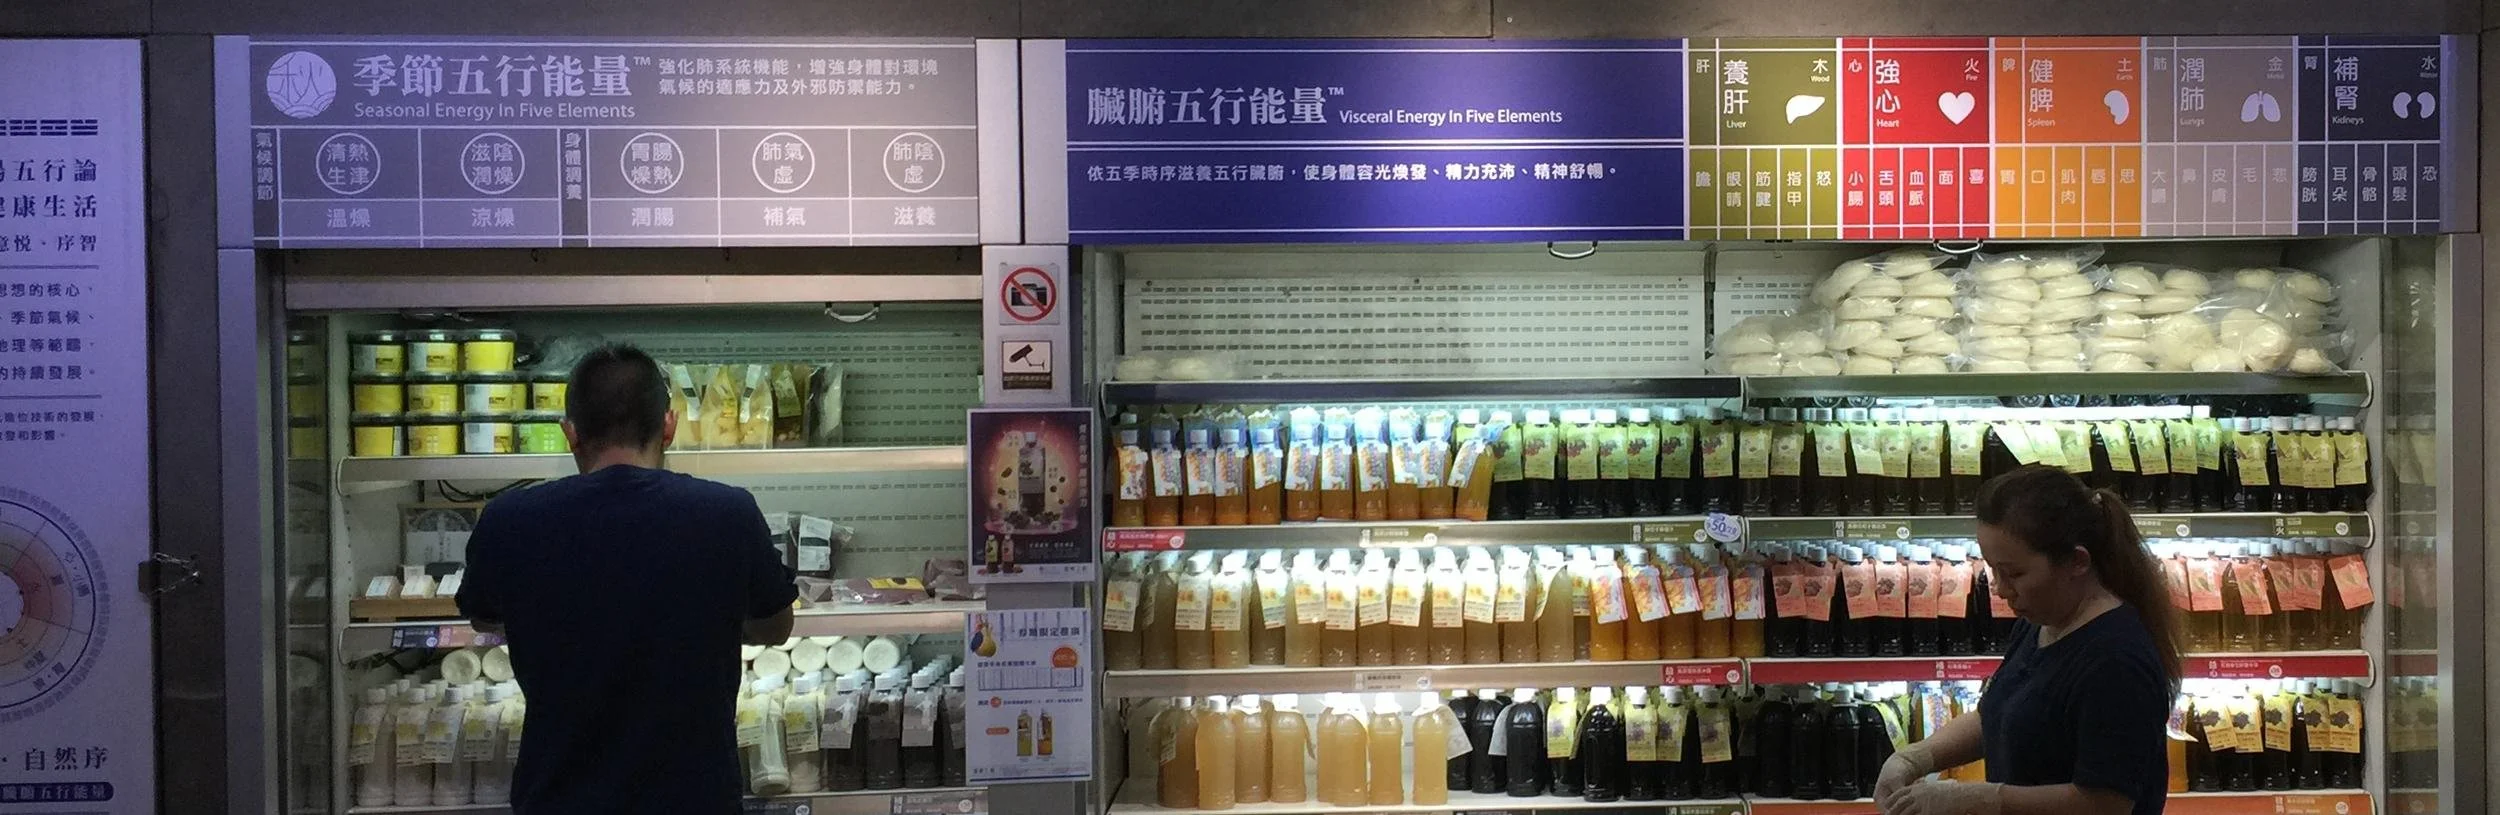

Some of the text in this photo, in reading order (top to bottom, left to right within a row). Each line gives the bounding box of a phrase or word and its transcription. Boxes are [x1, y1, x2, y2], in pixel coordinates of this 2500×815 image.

[1696, 59, 1710, 74] 肝
[1812, 58, 1828, 74] 木
[1848, 59, 1862, 73] 心
[1964, 58, 1980, 74] 火
[2003, 58, 2016, 72] 脾
[2117, 58, 2133, 72] 土
[2268, 57, 2283, 72] 金
[2304, 56, 2318, 70] 腎
[2421, 56, 2437, 71] 水
[1724, 59, 1749, 114] 養肝
[1875, 59, 1900, 113] 強心
[2028, 58, 2053, 113] 健脾
[2181, 57, 2205, 112] 潤肺
[2333, 56, 2358, 111] 補腎
[354, 103, 635, 122] Seasonal Energy In Five Elements
[1340, 109, 1562, 127] Visceral Energy In Five Elements
[2332, 115, 2365, 126] Kidneys
[1726, 119, 1746, 128] Liver
[1876, 119, 1900, 128] Heart
[2028, 118, 2055, 129] Spleen
[2180, 116, 2205, 127] Lungs
[255, 132, 275, 201] 氣候調節
[564, 132, 582, 200] 身體調養
[2422, 166, 2437, 182] 恐
[1816, 170, 1832, 187] 怒
[1939, 170, 1954, 185] 面
[1969, 169, 1984, 185] 喜
[2000, 169, 2015, 185] 胃
[2032, 171, 2045, 184] 口
[2120, 168, 2136, 183] 思
[2242, 167, 2257, 183] 毛
[1727, 171, 1742, 207] 眼睛
[1787, 171, 1802, 207] 指甲
[1848, 170, 1863, 207] 小腸
[1879, 170, 1894, 207] 舌頭
[2061, 169, 2076, 205] 肌肉
[2302, 166, 2317, 202] 膀胱
[2332, 166, 2348, 202] 耳朵
[2362, 166, 2377, 202] 骨骼
[2392, 166, 2407, 202] 頭髮
[764, 206, 806, 227] 補氣
[894, 206, 936, 226] 滋養
